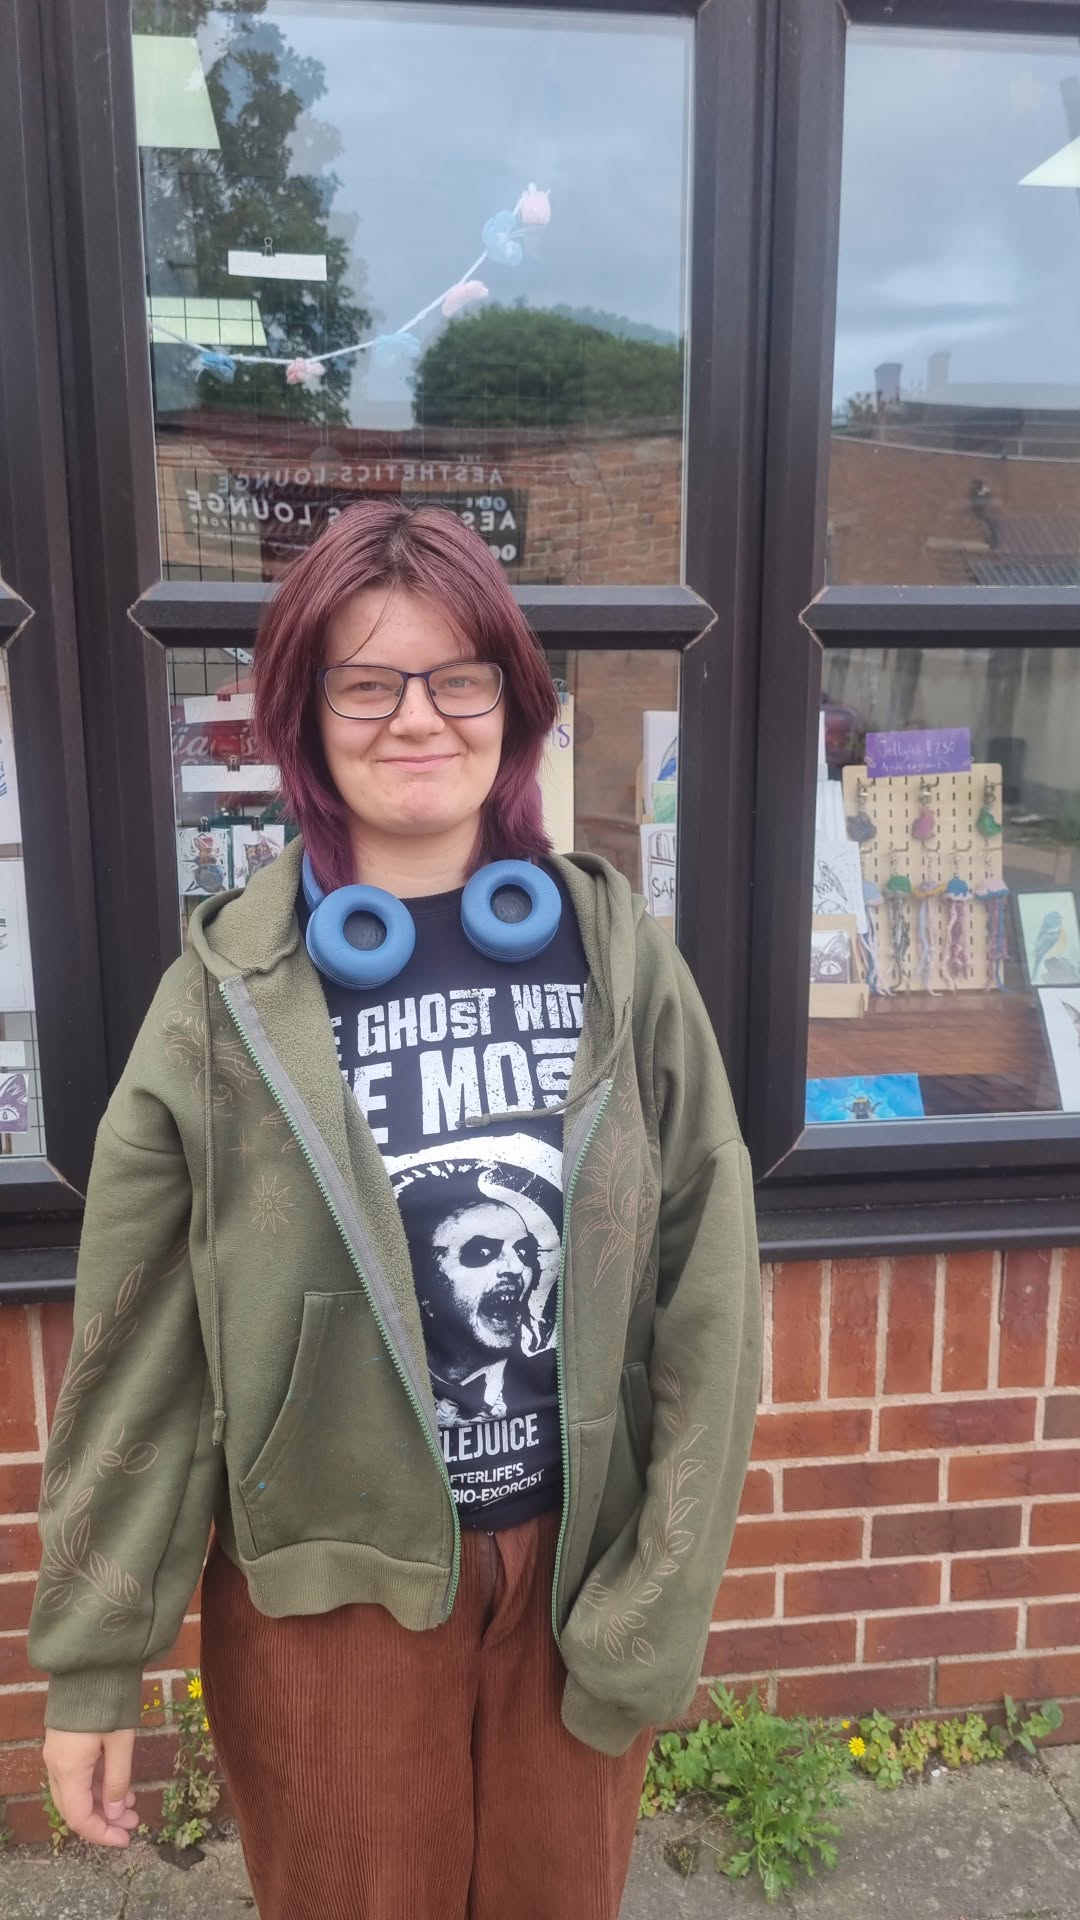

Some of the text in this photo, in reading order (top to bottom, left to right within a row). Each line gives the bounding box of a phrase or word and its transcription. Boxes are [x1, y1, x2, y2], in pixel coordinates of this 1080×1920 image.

[357, 987, 497, 1057] GHOST
[440, 1413, 540, 1463] LEJUICE
[450, 1462, 525, 1484] FTERLIFE'S
[452, 1468, 545, 1504] BIO-EXORCIST
